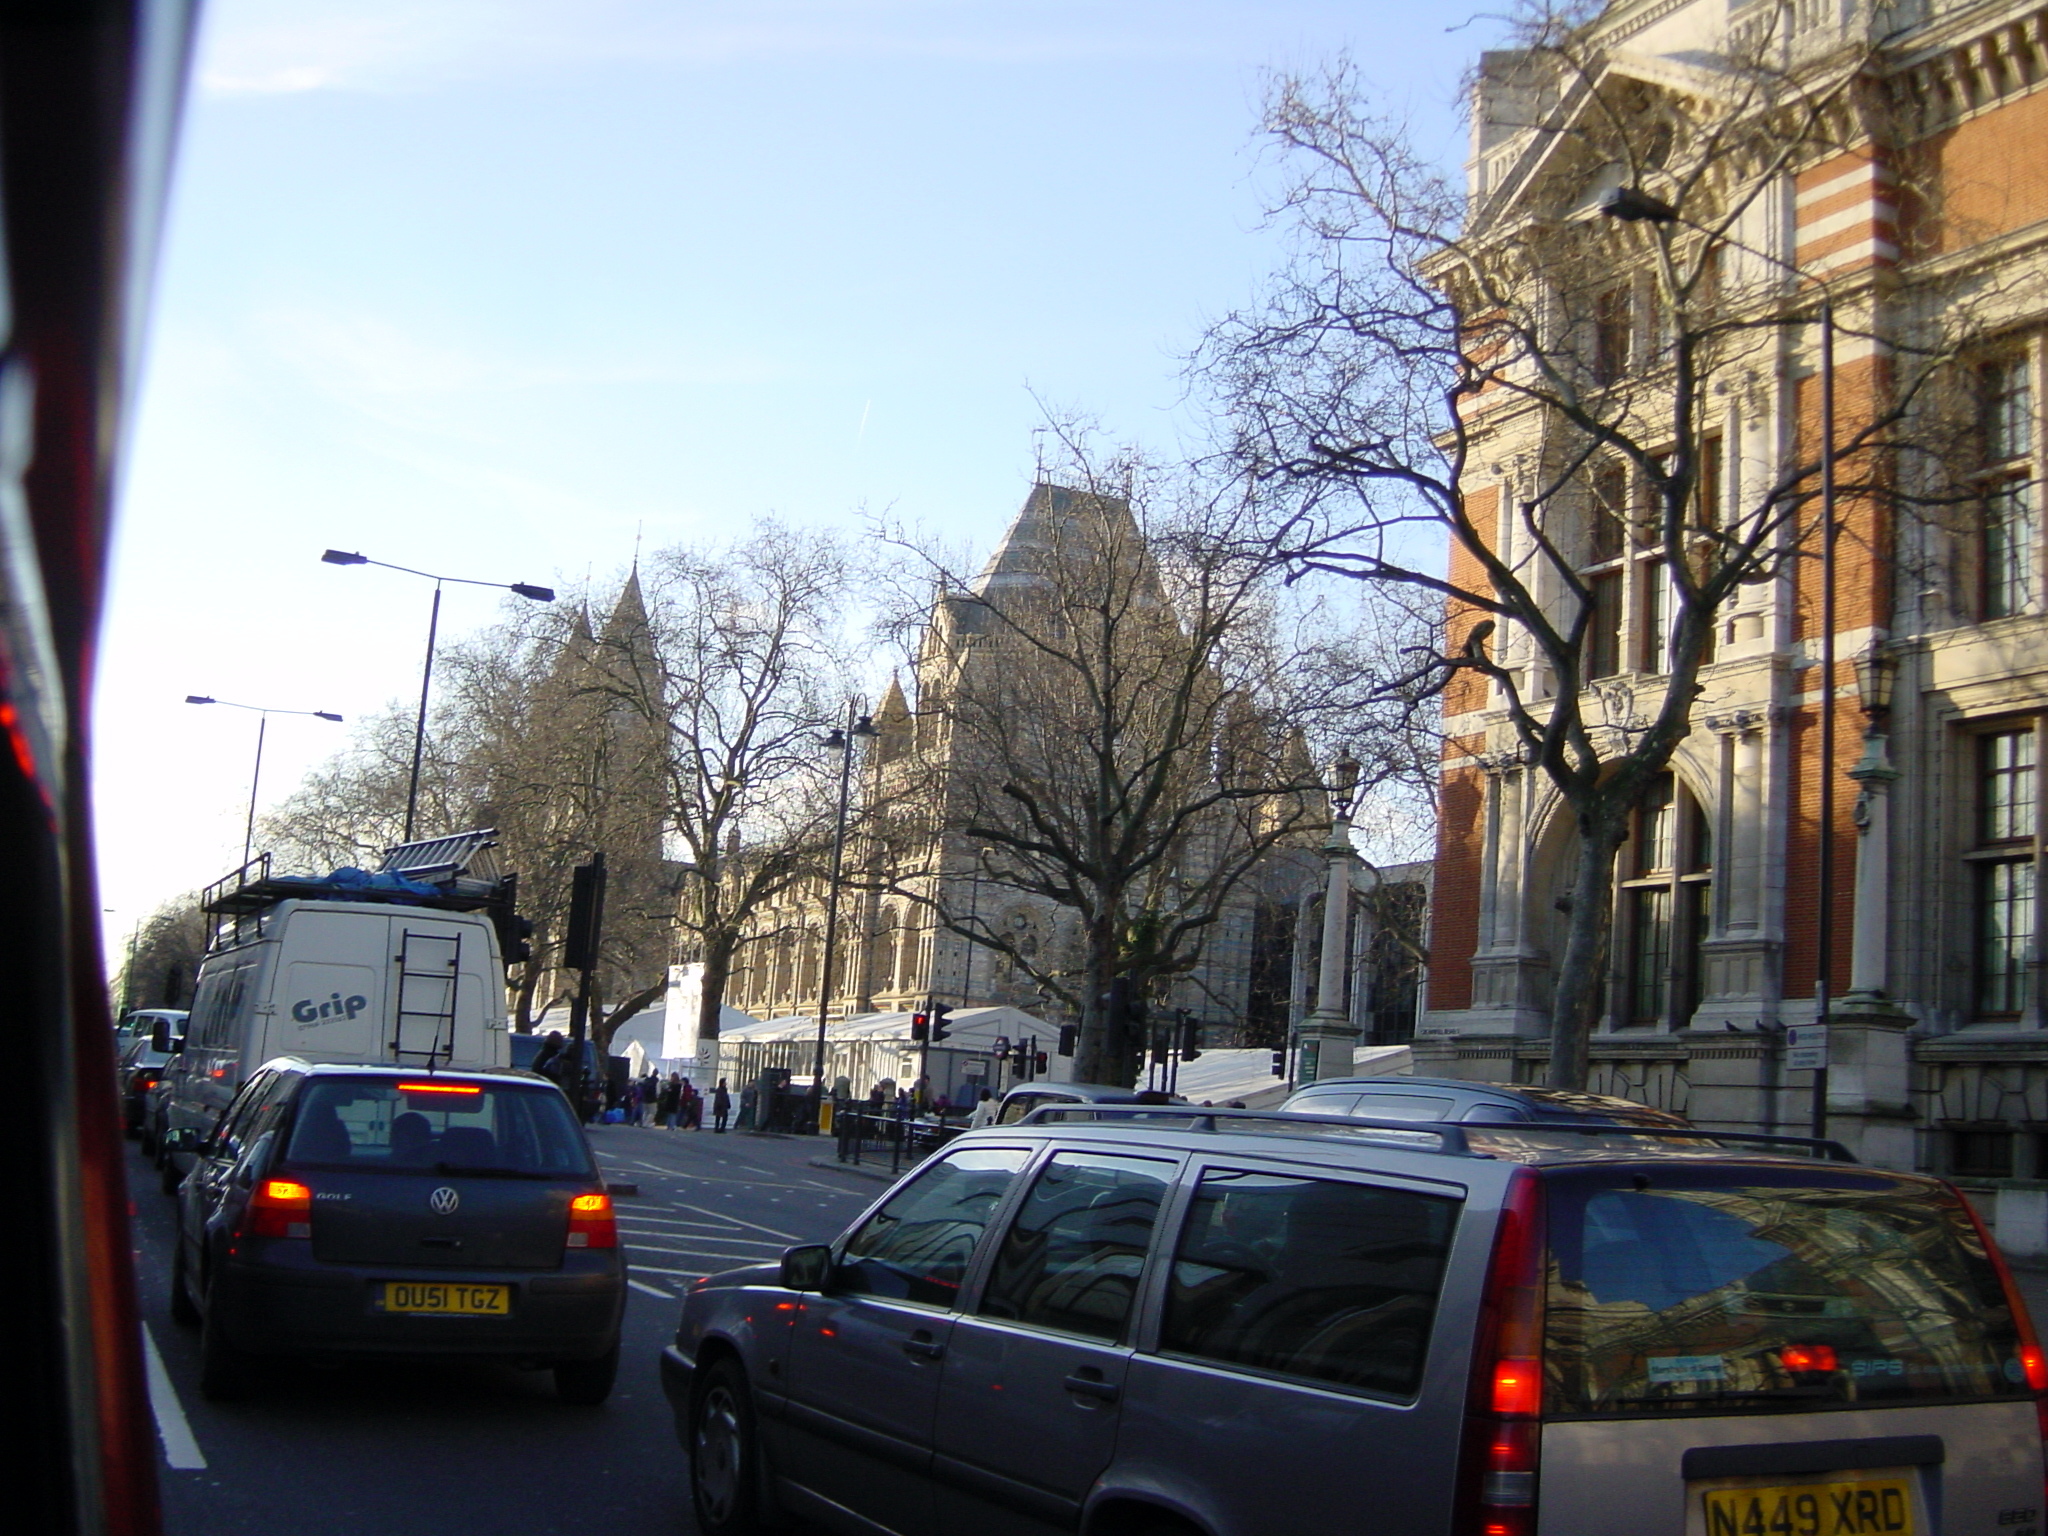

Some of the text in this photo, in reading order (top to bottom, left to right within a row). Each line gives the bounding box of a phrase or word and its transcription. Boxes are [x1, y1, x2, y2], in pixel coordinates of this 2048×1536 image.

[292, 992, 367, 1022] Grip
[316, 1192, 352, 1200] GOLF
[455, 1287, 500, 1309] TGZ
[1851, 1359, 1903, 1376] SIPS
[1711, 1487, 1906, 1536] N449 XRD
